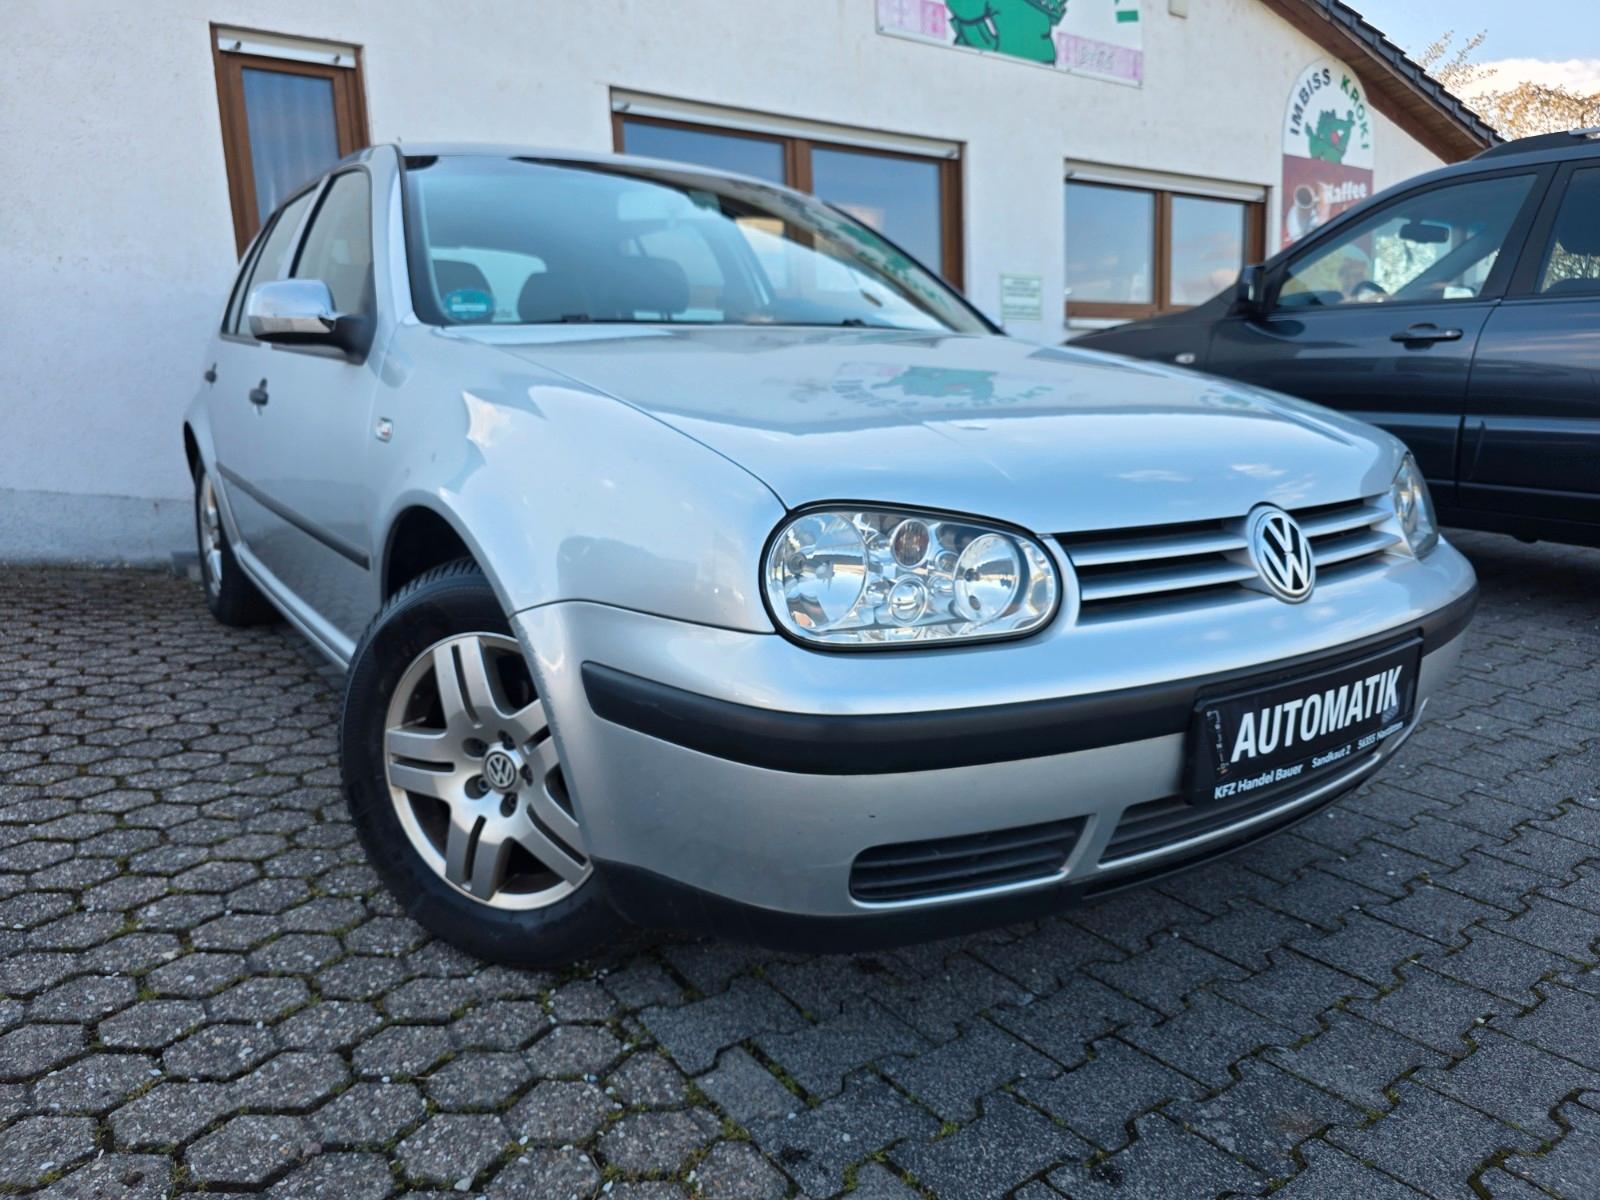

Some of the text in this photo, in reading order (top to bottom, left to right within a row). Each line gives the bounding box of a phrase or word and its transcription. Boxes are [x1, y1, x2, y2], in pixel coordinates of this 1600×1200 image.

[1290, 68, 1370, 150] IMBISS KROKI
[1323, 180, 1367, 204] Kaffee
[1230, 665, 1403, 763] AUTOMATIK
[1214, 782, 1237, 800] KFZ
[1237, 770, 1274, 793] Handel
[1275, 764, 1304, 781] Bauer
